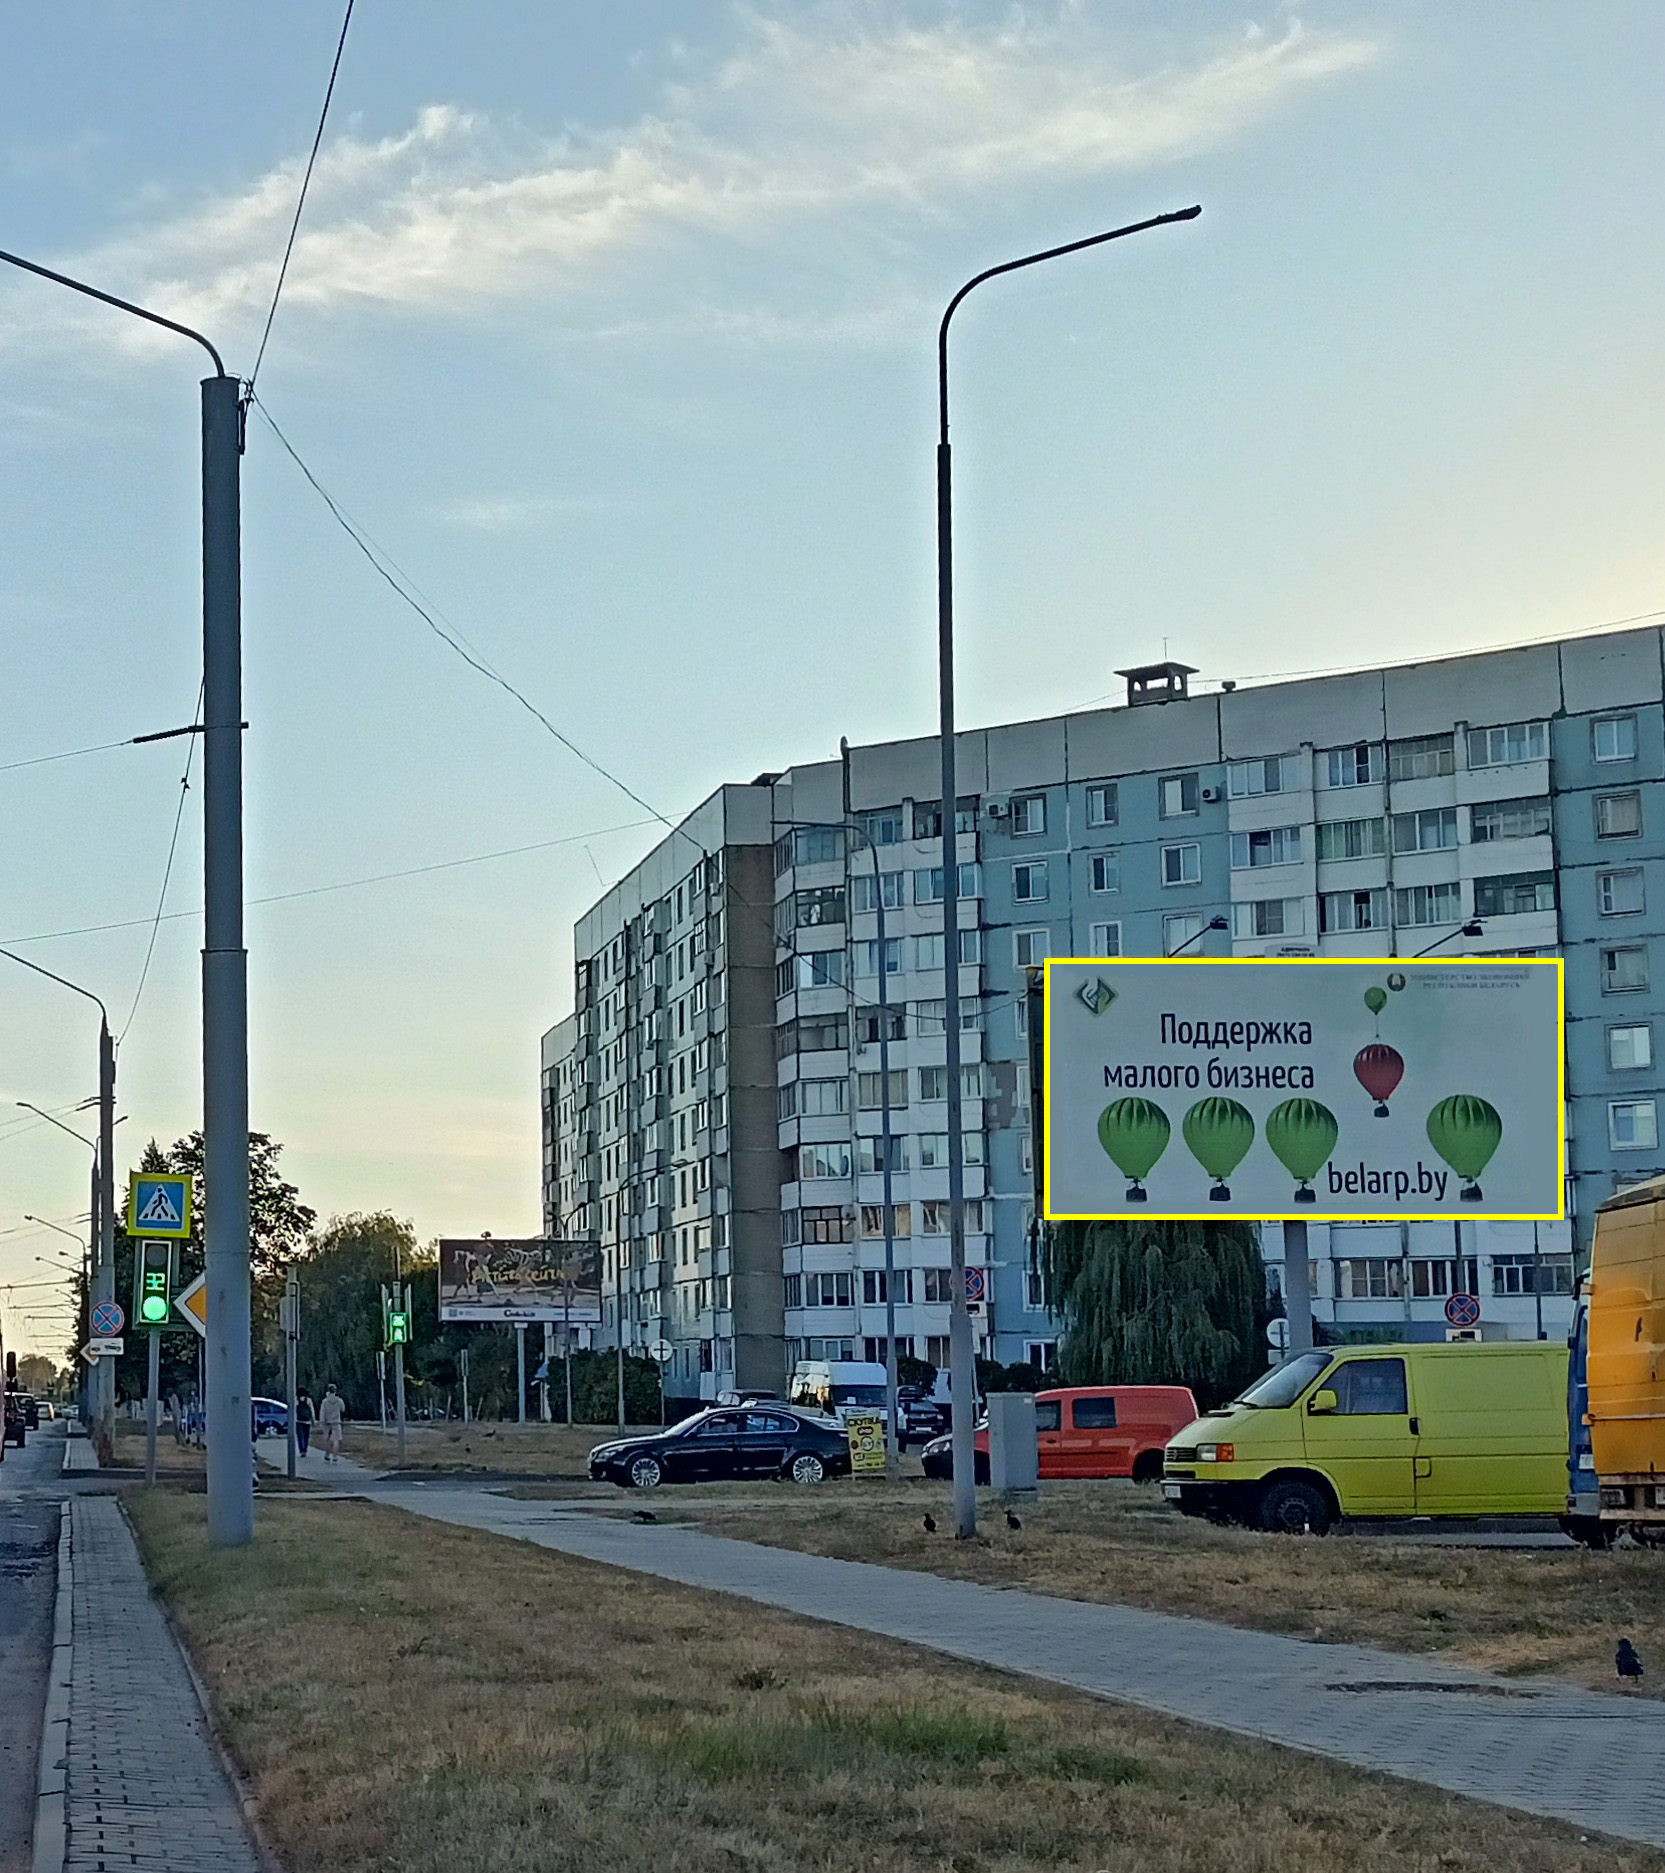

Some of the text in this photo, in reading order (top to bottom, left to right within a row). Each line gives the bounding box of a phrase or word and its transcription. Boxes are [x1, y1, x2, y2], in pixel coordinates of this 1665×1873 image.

[1160, 1013, 1313, 1051] Поддержка
[1103, 1057, 1315, 1089] малого бизнеса
[1327, 1161, 1449, 1202] belarp.by
